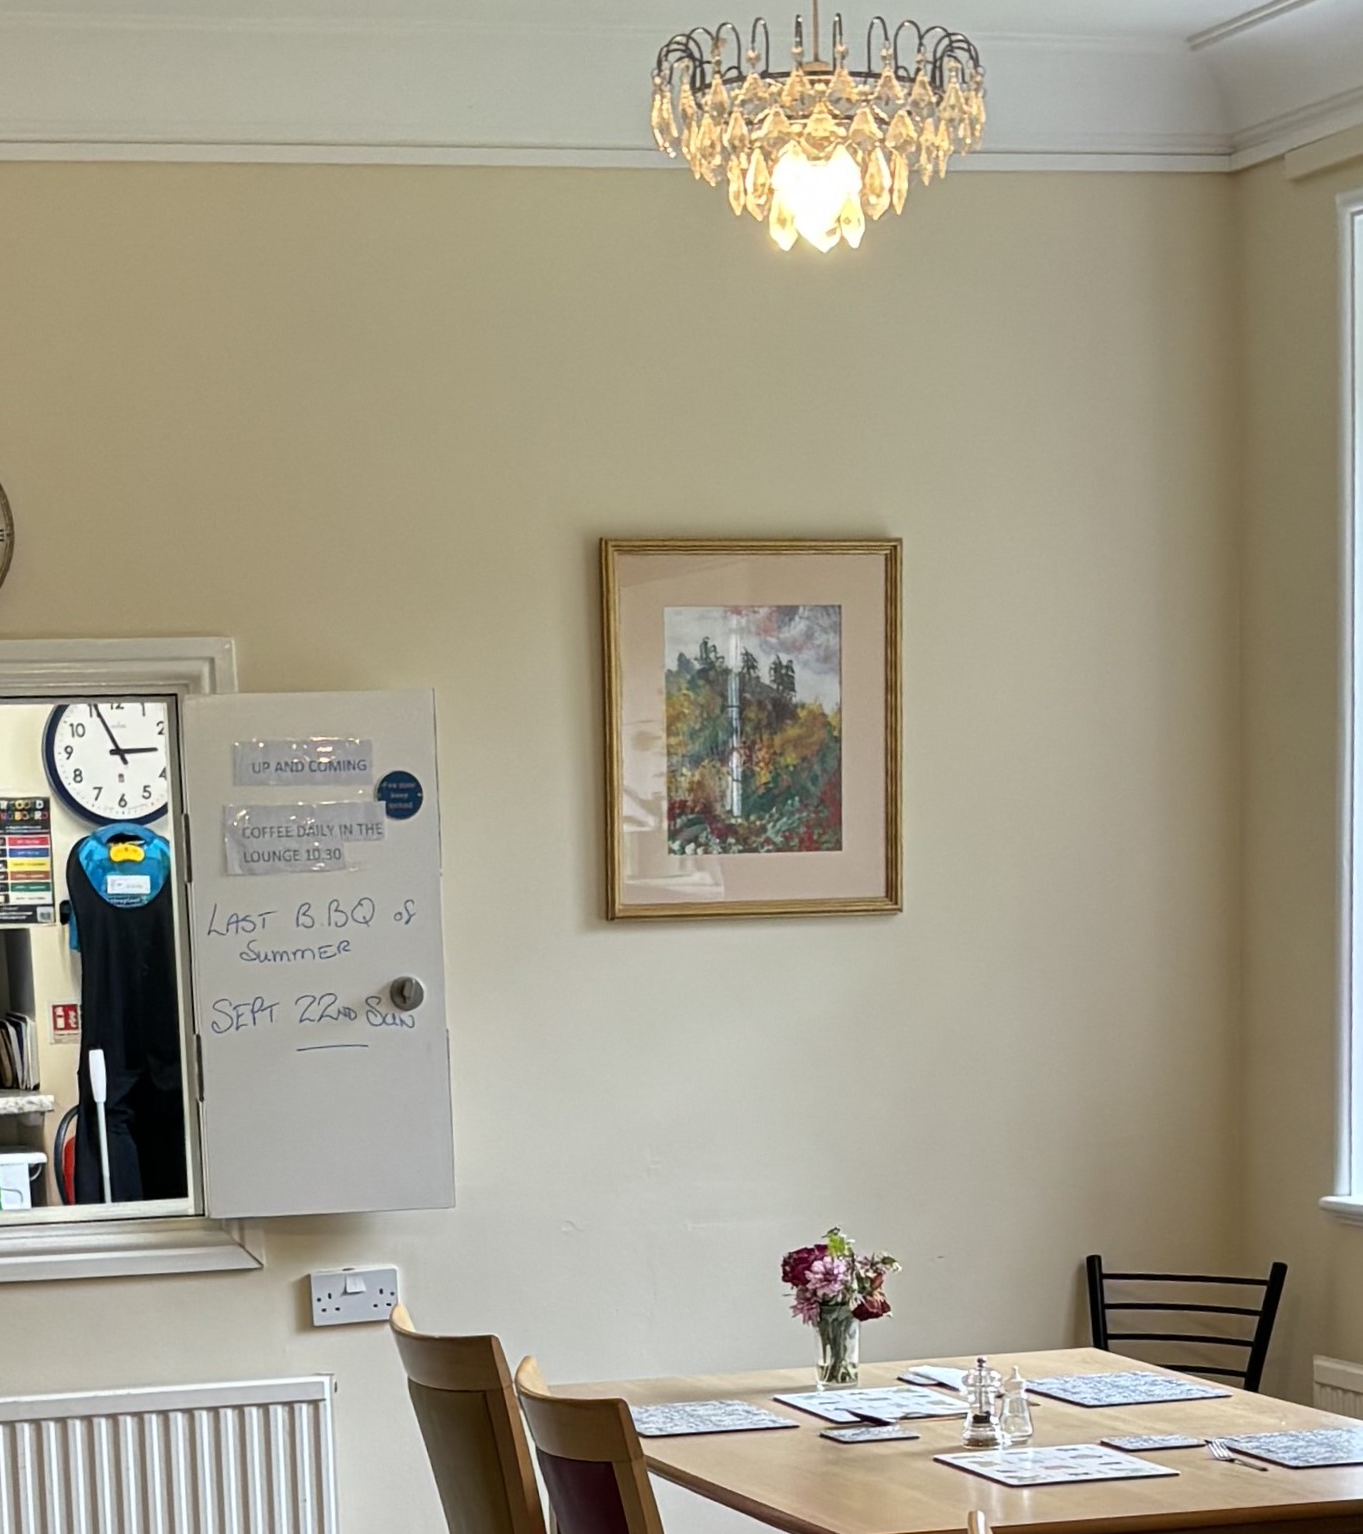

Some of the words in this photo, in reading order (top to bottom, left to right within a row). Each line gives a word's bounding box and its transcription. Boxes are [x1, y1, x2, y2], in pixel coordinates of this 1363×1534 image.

[69, 722, 86, 738] 10
[64, 745, 74, 760] 9
[252, 761, 271, 774] UP
[275, 760, 305, 773] AND
[308, 759, 368, 772] COMING
[72, 768, 83, 784] 8
[92, 786, 103, 801] 7
[142, 785, 152, 800] 5
[118, 793, 128, 808] 6
[241, 826, 294, 839] COFFEE
[297, 823, 336, 838] DAILY
[339, 823, 353, 836] IN
[356, 822, 384, 836] THE
[243, 850, 300, 863] LOUNGE
[207, 903, 278, 936] LAST
